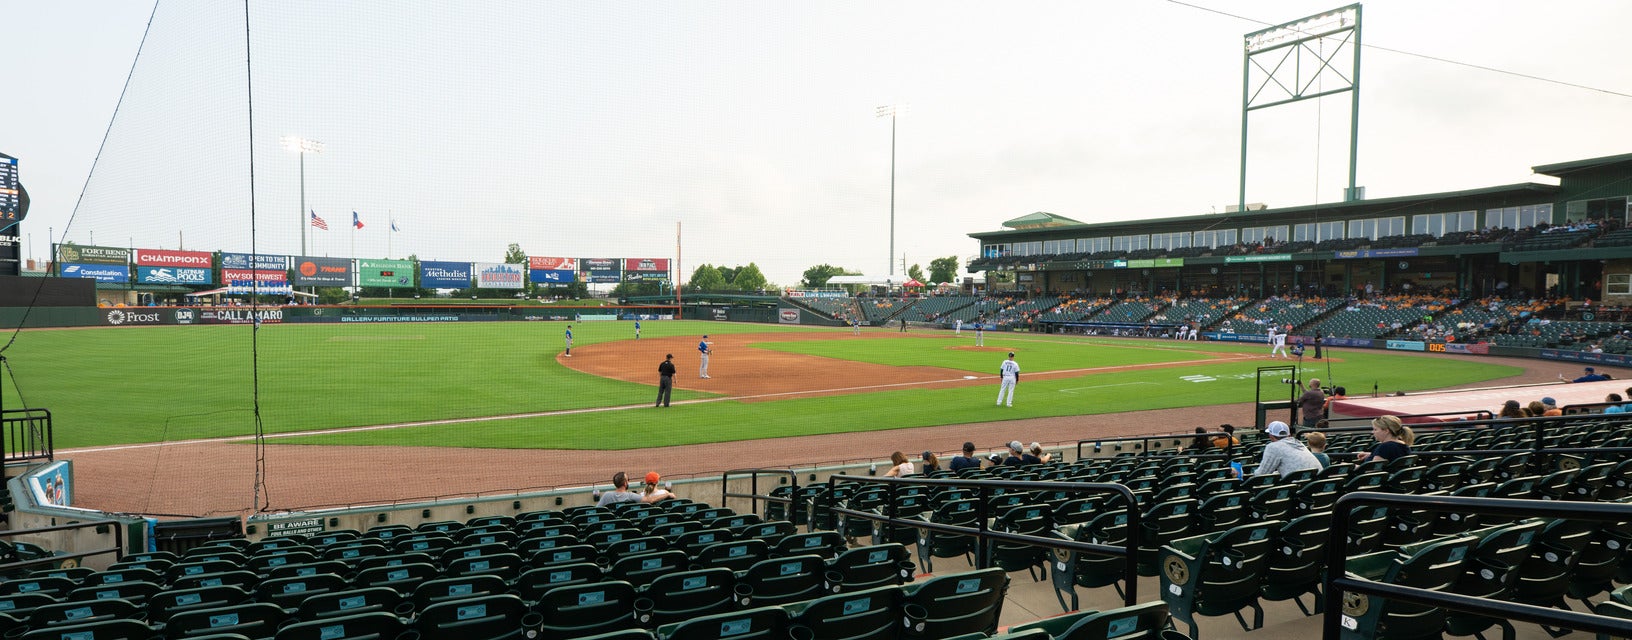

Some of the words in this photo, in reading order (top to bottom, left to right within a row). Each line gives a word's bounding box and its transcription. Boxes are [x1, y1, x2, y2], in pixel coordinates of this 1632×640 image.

[426, 269, 467, 278] Methodist
[126, 312, 160, 322] Frost
[218, 310, 243, 320] CALL
[1344, 617, 1350, 626] K
